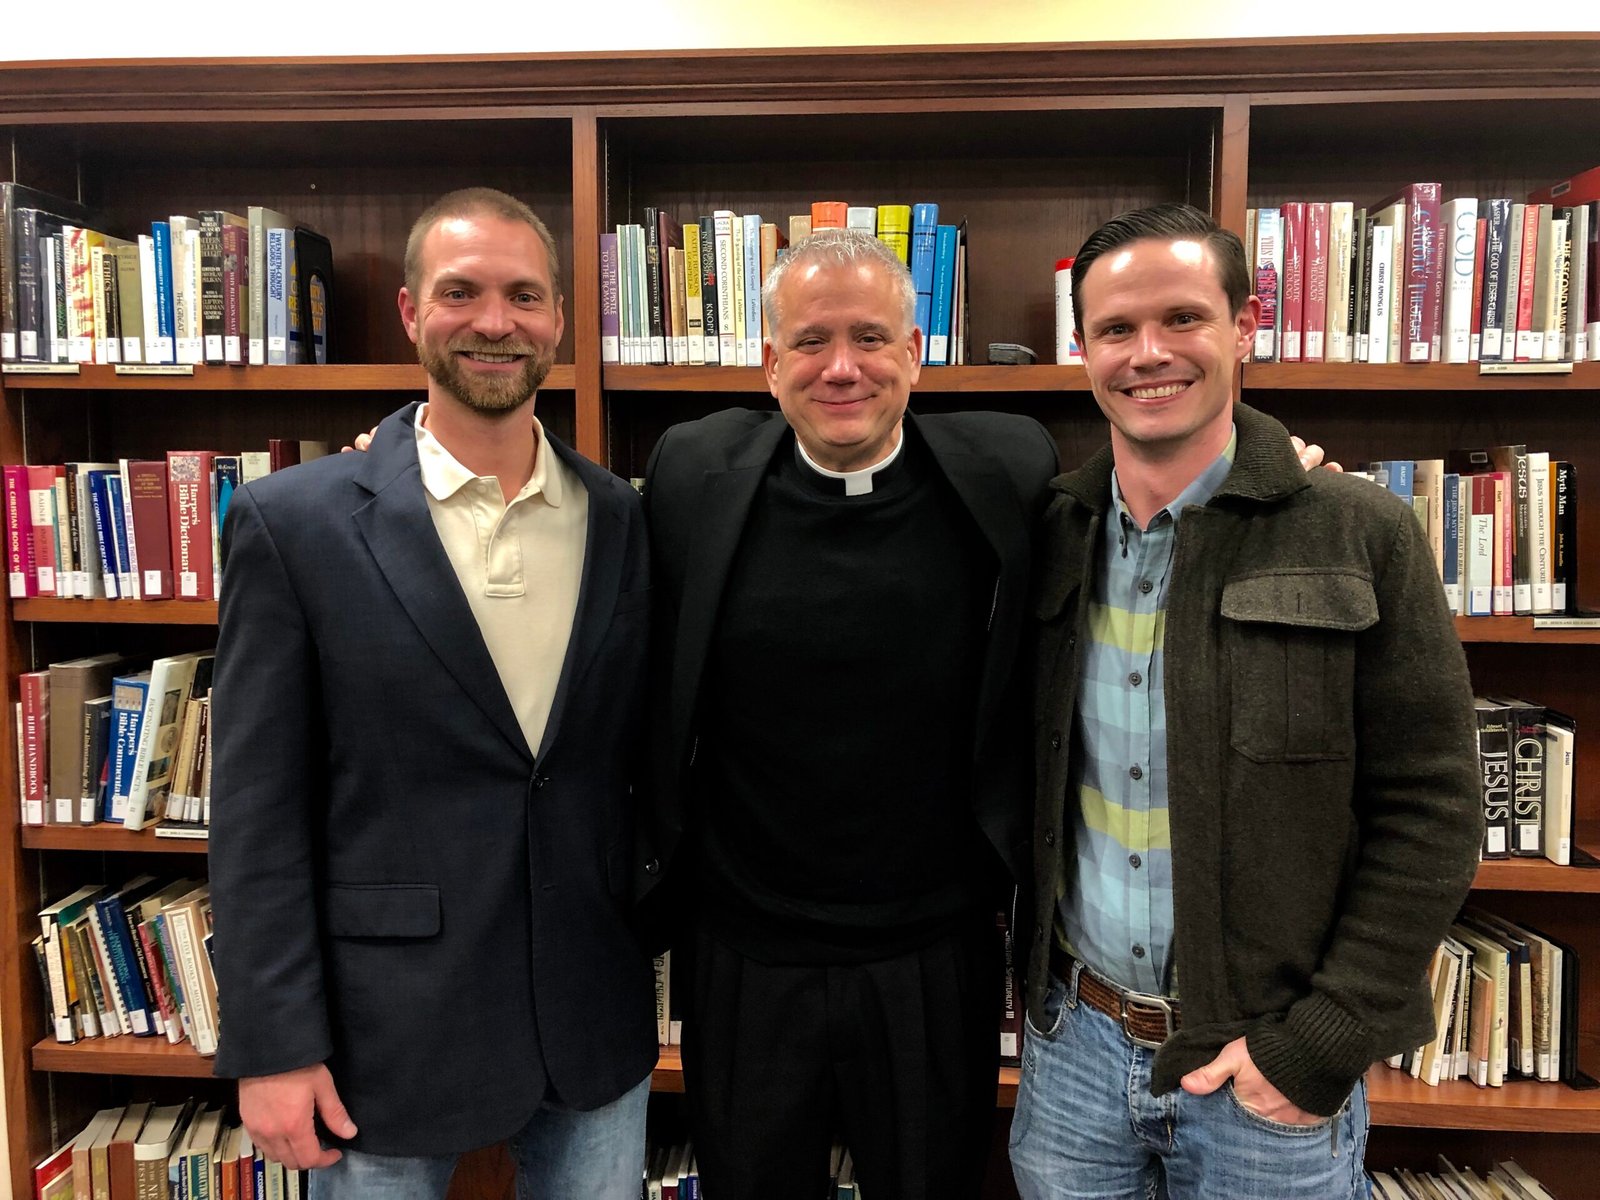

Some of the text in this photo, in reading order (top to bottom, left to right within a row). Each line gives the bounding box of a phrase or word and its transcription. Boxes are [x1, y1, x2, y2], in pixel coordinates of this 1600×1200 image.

[602, 250, 609, 263] TO
[719, 239, 727, 270] SECOND
[1455, 211, 1477, 277] GOD
[1564, 240, 1572, 259] THE
[104, 260, 112, 292] ETHICS
[269, 233, 277, 299] RELIGIOUS THOUGHT
[1489, 270, 1498, 281] OF
[1490, 253, 1499, 270] GOD
[1286, 259, 1294, 301] THEOLOGY
[1293, 255, 1301, 303] SYSTEMATIC
[1310, 260, 1318, 302] THEOLOGY
[1317, 256, 1326, 304] SYSTEMATIC
[1560, 261, 1571, 304] SECOND
[720, 271, 729, 321] CORINTHIANS
[653, 306, 661, 325] PAUL
[706, 303, 714, 334] KNOPP
[1377, 308, 1384, 316] US
[1536, 479, 1545, 497] JESUS
[1557, 469, 1568, 493] Myth
[10, 491, 18, 529] CHRISTIAN
[179, 484, 190, 515] Bible
[1558, 494, 1567, 515] Man
[93, 503, 103, 530] COMPLETE
[11, 531, 19, 552] BOOK
[1478, 517, 1489, 557] The Lord
[13, 554, 19, 563] OF
[129, 546, 138, 574] THEOLOG
[127, 712, 139, 756] Harper's
[27, 715, 37, 796] BIBLE HANDBOOK
[112, 712, 128, 797] Bible Commenta
[1481, 752, 1509, 821] JESUS
[1514, 738, 1543, 831] CHRIST
[138, 1162, 146, 1200] TESTAME
[148, 1184, 158, 1200] NE
